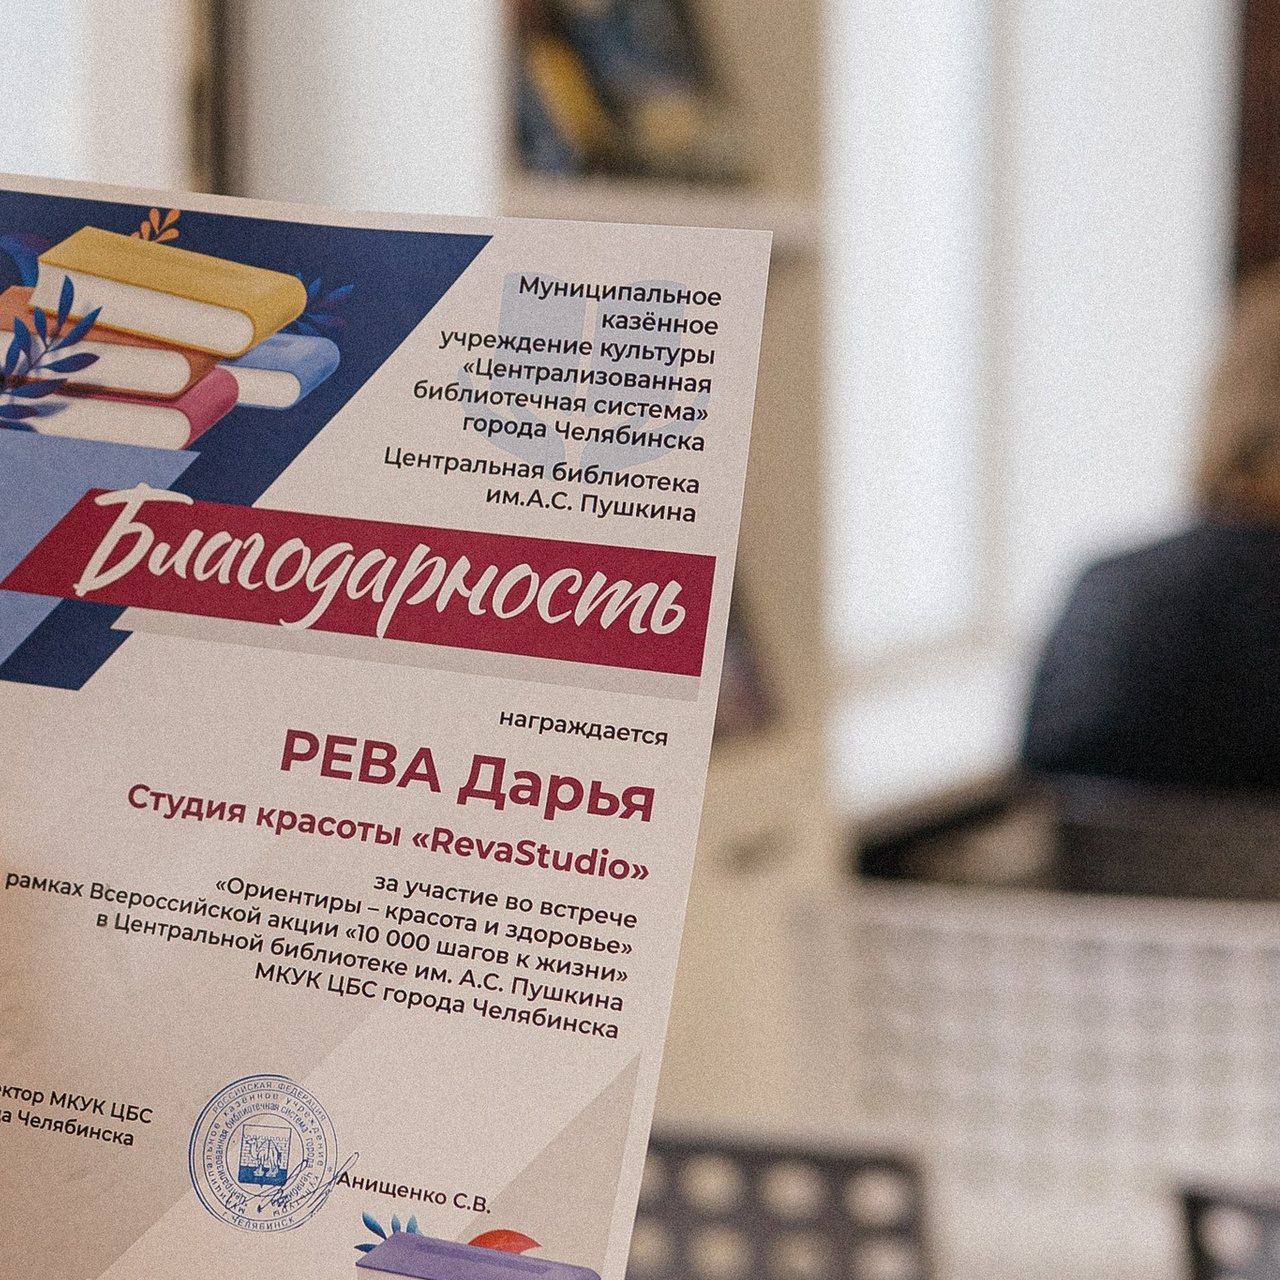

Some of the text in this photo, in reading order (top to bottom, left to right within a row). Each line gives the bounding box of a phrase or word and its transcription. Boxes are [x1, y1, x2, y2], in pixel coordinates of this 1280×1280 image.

[518, 275, 722, 307] Муниципальное
[601, 311, 719, 336] казённое
[438, 330, 716, 368] учреждение культуры
[462, 357, 712, 395] «Централизованная
[413, 379, 709, 422] библиотечная система»
[462, 416, 705, 452] города Челябинска
[383, 445, 700, 495] Центральная библиотека
[485, 488, 697, 523] им.А.С. Пушкина
[72, 481, 688, 639] Благодарность
[499, 711, 669, 747] награждается
[279, 728, 656, 823] РЕВА Дарья
[127, 783, 650, 881] Студия красоты «RevaStudio»
[215, 876, 362, 915] «Ориентиры
[384, 904, 478, 933] красота
[483, 920, 500, 936] и
[504, 923, 633, 955] здоровье»
[373, 875, 638, 929] за участие во встрече
[4, 872, 85, 898] рамках
[89, 881, 262, 926] Всероссийской
[267, 913, 340, 938] акции
[345, 923, 380, 944] «10
[385, 928, 431, 952] 000
[435, 940, 510, 965] шагов
[515, 952, 531, 969] к
[534, 955, 629, 983] жизни»
[95, 912, 624, 1012] в Центральной библиотеке им. А.С. Пушкина
[254, 961, 619, 1040] МКУК ЦБС города Челябинска
[49, 1090, 107, 1116] МКУК
[110, 1102, 154, 1124] ЦБС
[277, 1082, 327, 1122] ФЕДЕРАЦИЯ
[17, 1109, 135, 1147] Челябинска
[335, 1170, 491, 1215] Анищенко С.В.
